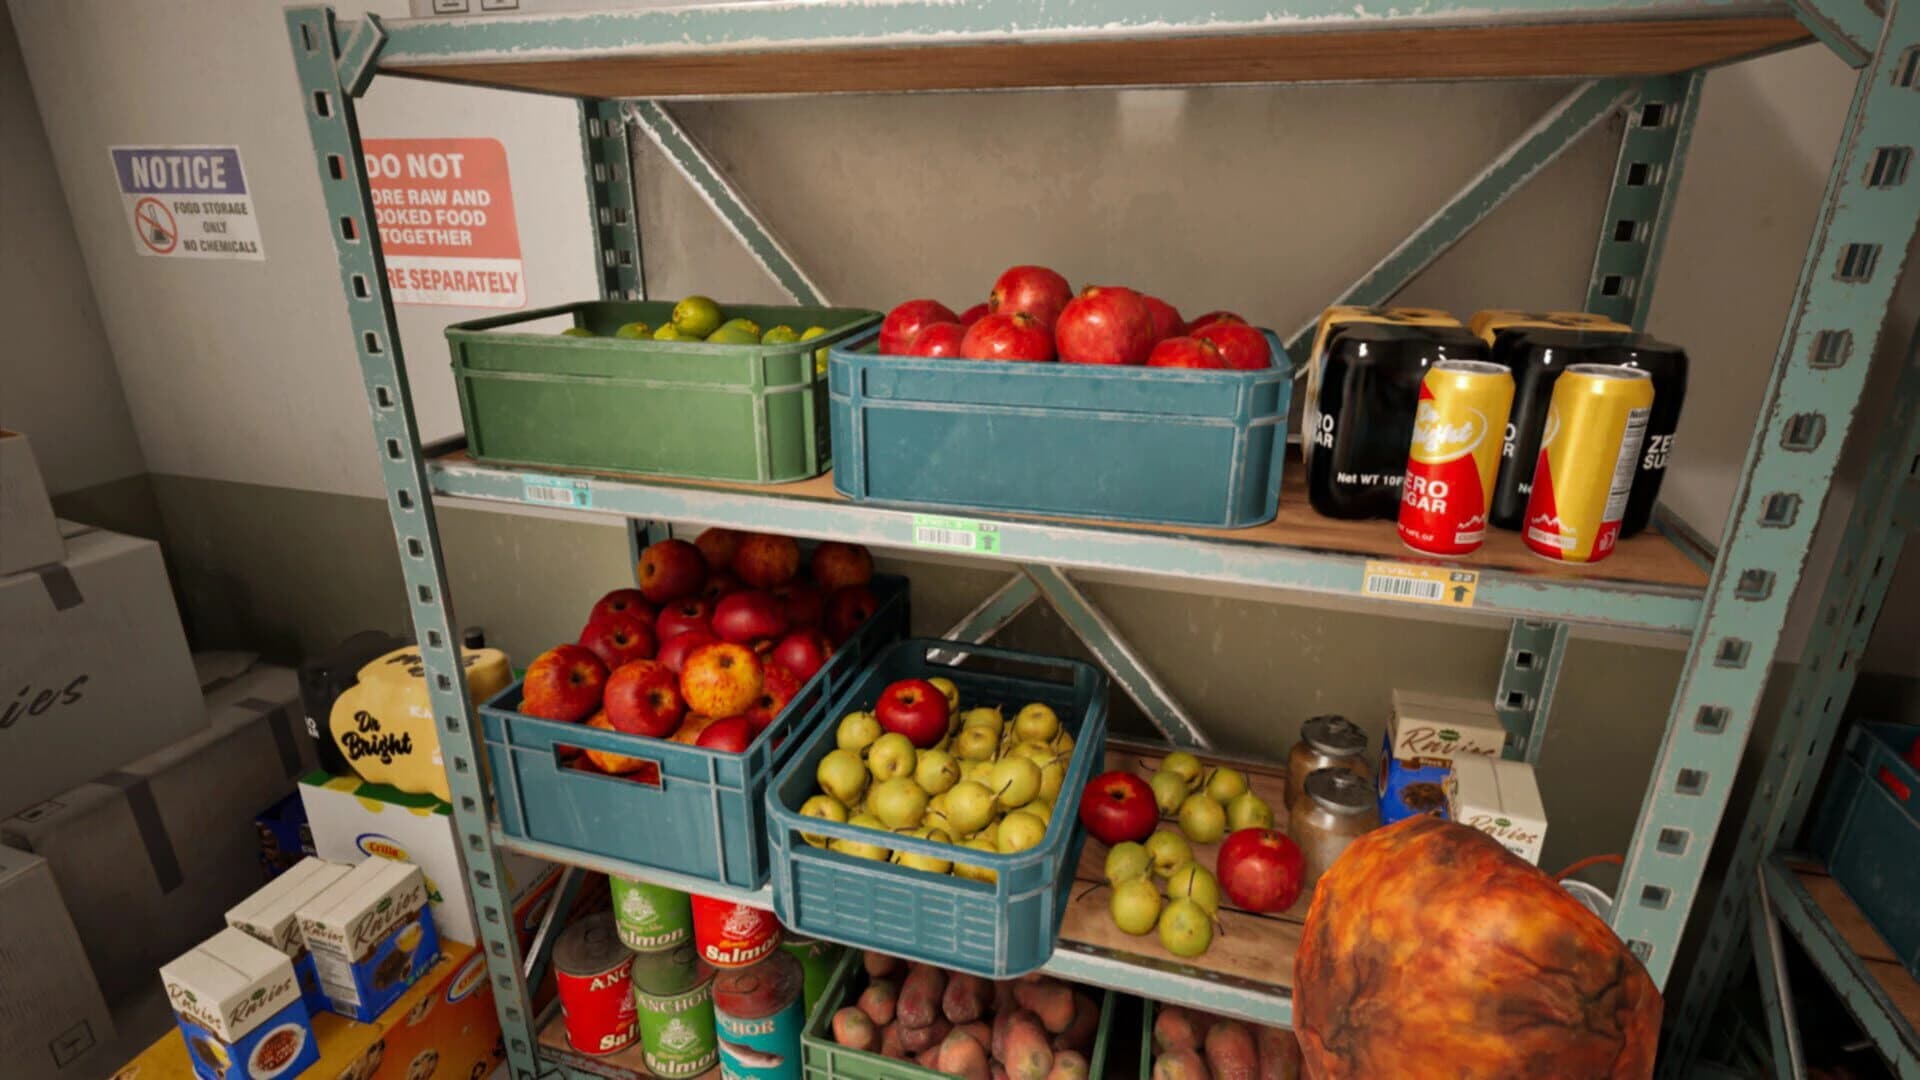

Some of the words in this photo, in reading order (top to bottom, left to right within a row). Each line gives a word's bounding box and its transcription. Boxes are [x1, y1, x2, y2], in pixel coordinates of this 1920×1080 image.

[131, 155, 227, 189] NOTICE
[366, 153, 401, 178] DO
[406, 153, 464, 178] NOT
[371, 188, 404, 205] ORE
[408, 189, 447, 205] RAW
[452, 189, 491, 206] AND
[173, 203, 200, 214] FOOD
[203, 202, 248, 215] STORAGE
[375, 208, 432, 225] OOKED
[435, 209, 487, 226] FOOD
[203, 221, 227, 233] ONLY
[379, 228, 472, 246] TOGETHER
[183, 239, 198, 251] NO
[201, 240, 257, 253] CHEMICALS
[409, 270, 519, 293] SEPARATELY
[1648, 434, 1675, 454] ZE
[1337, 472, 1357, 484] Net
[1360, 474, 1379, 486] WT
[1383, 475, 1405, 487] 10F
[1405, 471, 1449, 499] ERO
[354, 710, 381, 733] Dr
[341, 731, 413, 766] Bright
[618, 926, 685, 947] almon
[705, 929, 780, 963] Salmon
[588, 967, 630, 993] ANC
[599, 1023, 638, 1050] Sal
